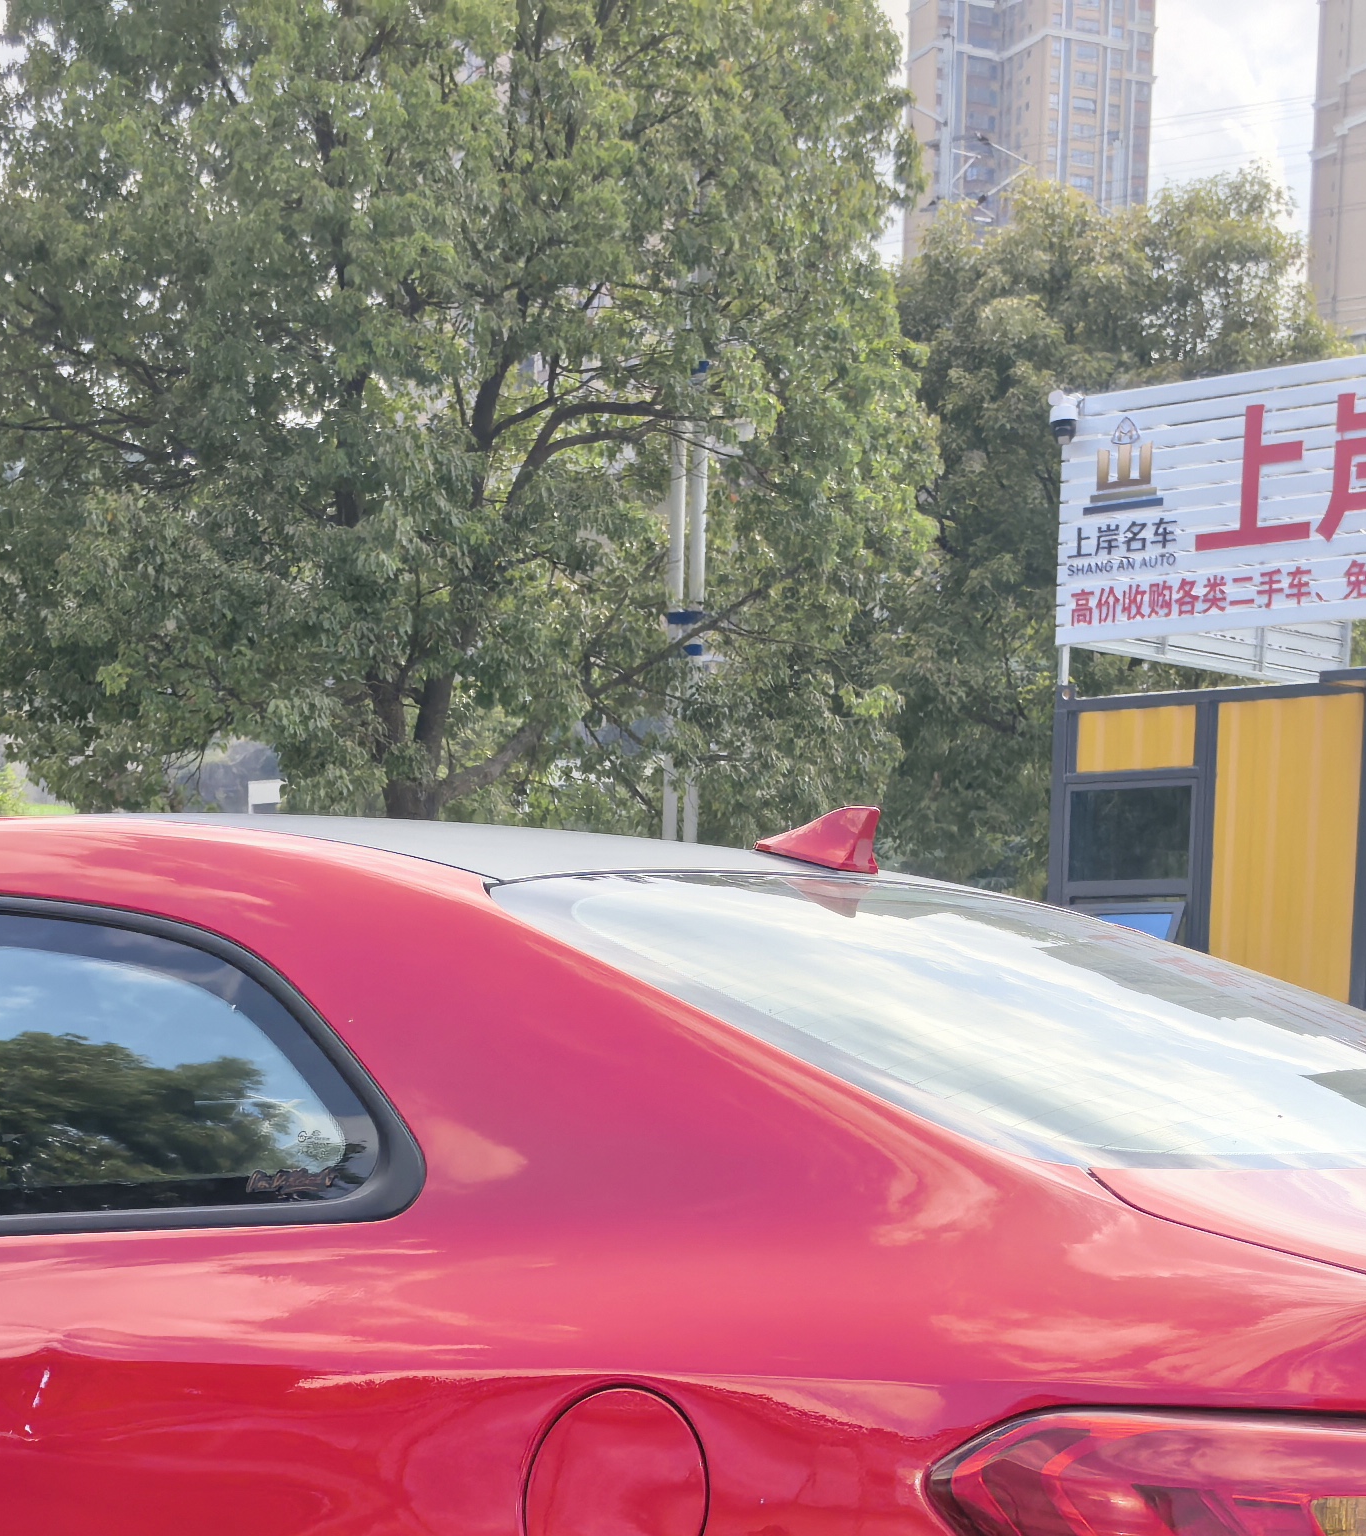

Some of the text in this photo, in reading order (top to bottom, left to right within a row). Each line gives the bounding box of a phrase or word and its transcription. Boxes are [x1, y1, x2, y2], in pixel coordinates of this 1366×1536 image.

[1066, 517, 1178, 560] 上岸名车
[1067, 553, 1177, 577] SHANG AN AUTO
